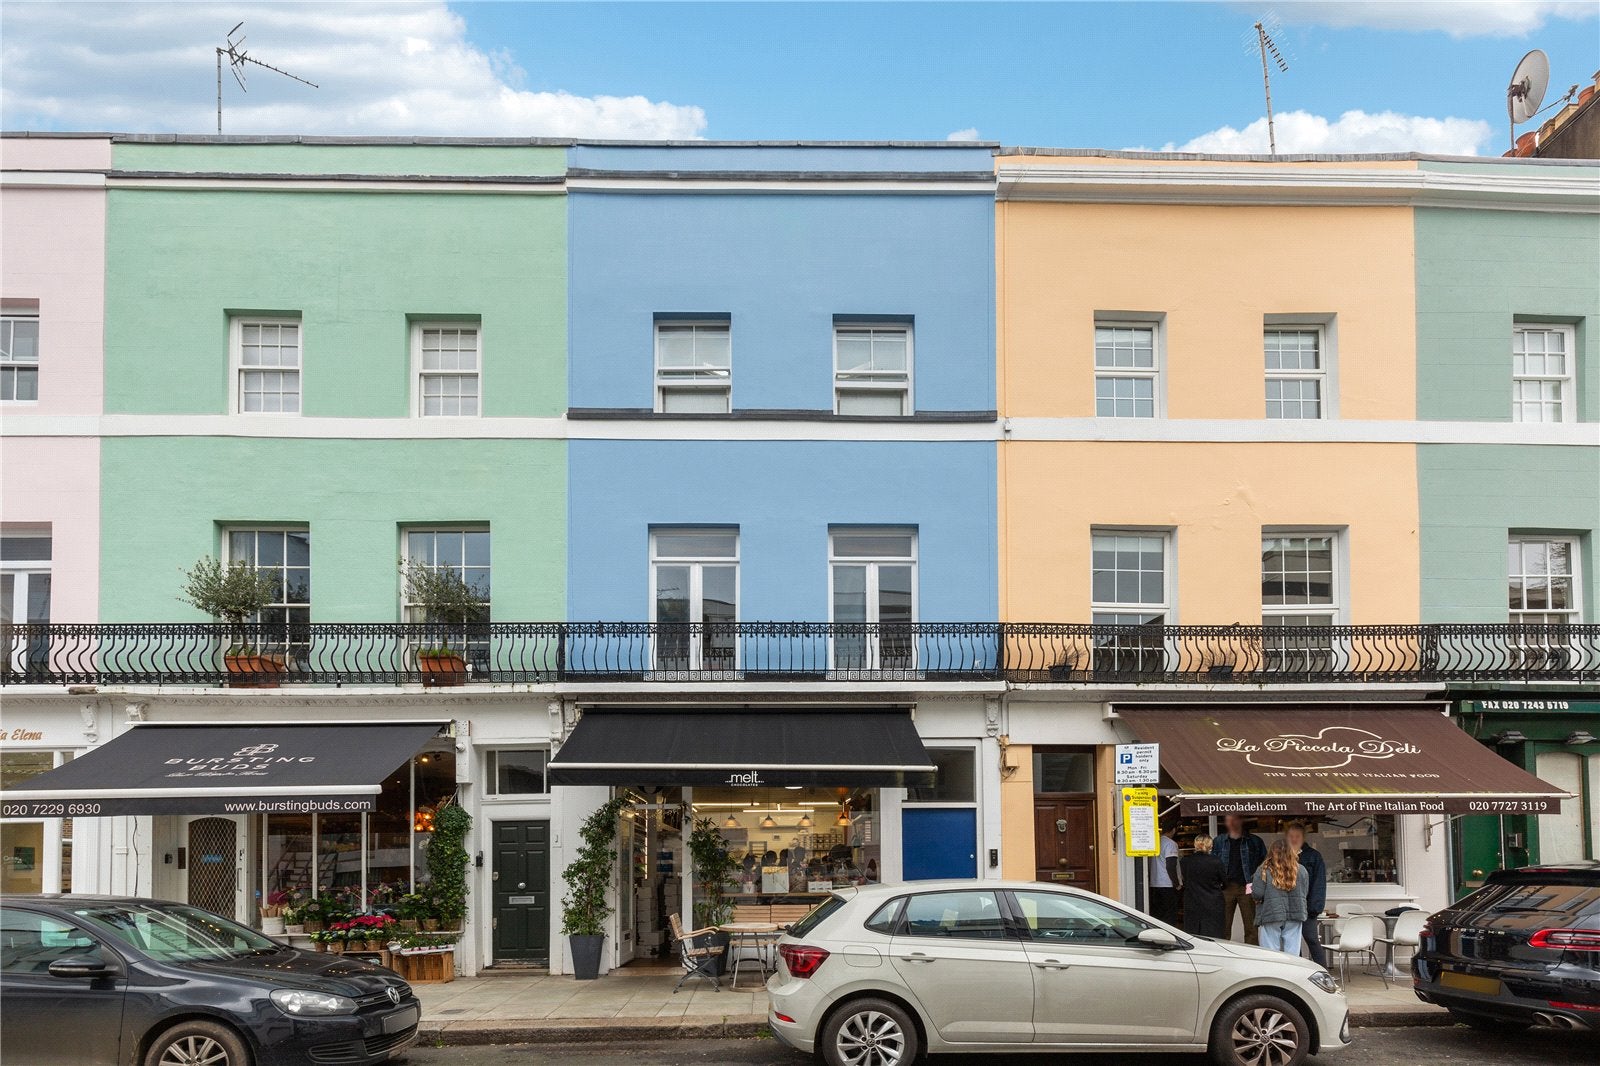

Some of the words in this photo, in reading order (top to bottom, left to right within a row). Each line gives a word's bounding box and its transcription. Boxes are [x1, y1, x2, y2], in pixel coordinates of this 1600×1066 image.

[1481, 700, 1500, 709] FAX
[1502, 700, 1520, 709] 020
[1521, 700, 1545, 709] 7243
[1546, 701, 1569, 710] 5719
[11, 728, 43, 741] Elena
[1216, 737, 1261, 752] La
[1263, 737, 1355, 754] Piccola
[1358, 739, 1422, 754] Deli
[164, 756, 315, 764] BURSTING
[188, 763, 270, 771] BUDS
[3, 804, 28, 816] 020
[32, 803, 65, 815] 7229
[68, 803, 101, 814] 6930
[224, 799, 371, 813] www.burstingbuds.com
[1196, 802, 1288, 814] Lapiccoladeli.com
[1304, 801, 1325, 811] The
[1327, 801, 1345, 811] Art
[1346, 801, 1358, 811] of
[1359, 801, 1382, 811] Fine
[1384, 801, 1418, 811] Italian
[1420, 801, 1445, 811] Food
[1469, 801, 1490, 811] 020
[1491, 801, 1519, 811] 7727
[1521, 801, 1548, 811] 3119
